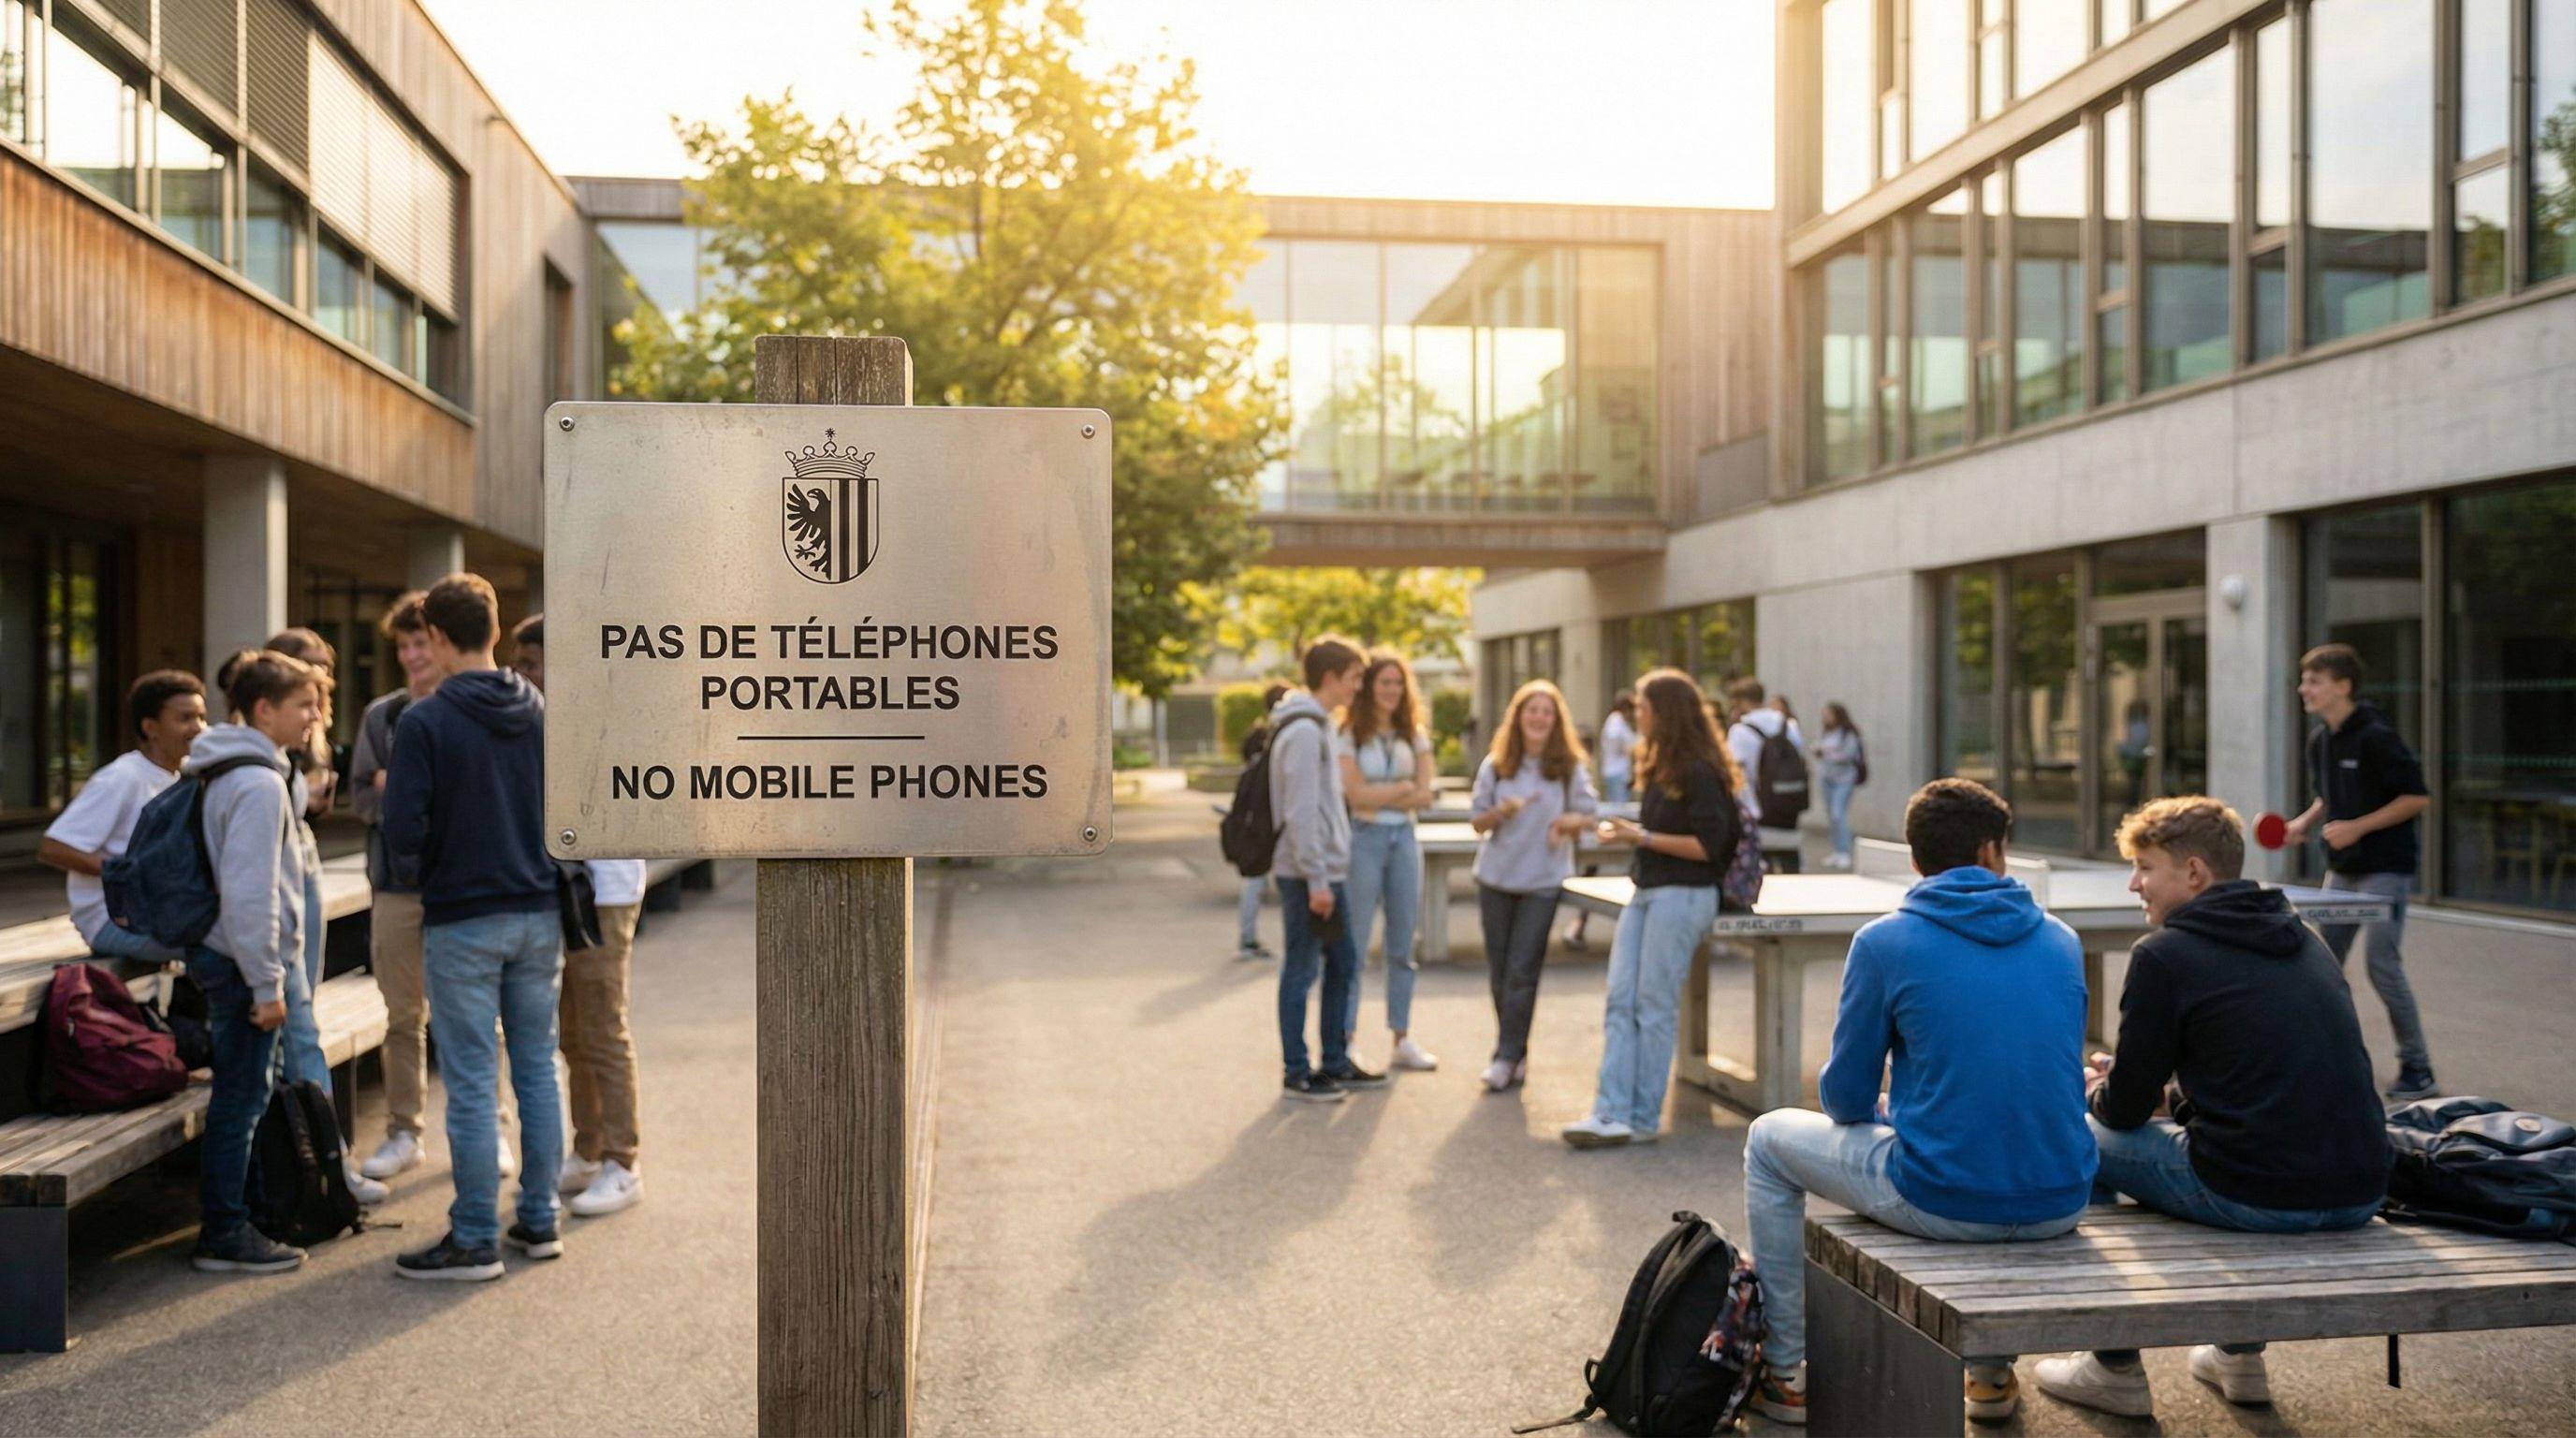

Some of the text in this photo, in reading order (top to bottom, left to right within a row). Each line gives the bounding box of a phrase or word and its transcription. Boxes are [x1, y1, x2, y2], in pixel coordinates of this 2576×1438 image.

[602, 616, 1059, 659] PAS DE TÉLÉPHONES
[701, 675, 960, 711] PORTABLES
[612, 764, 1048, 800] NO MOBILE PHONES
